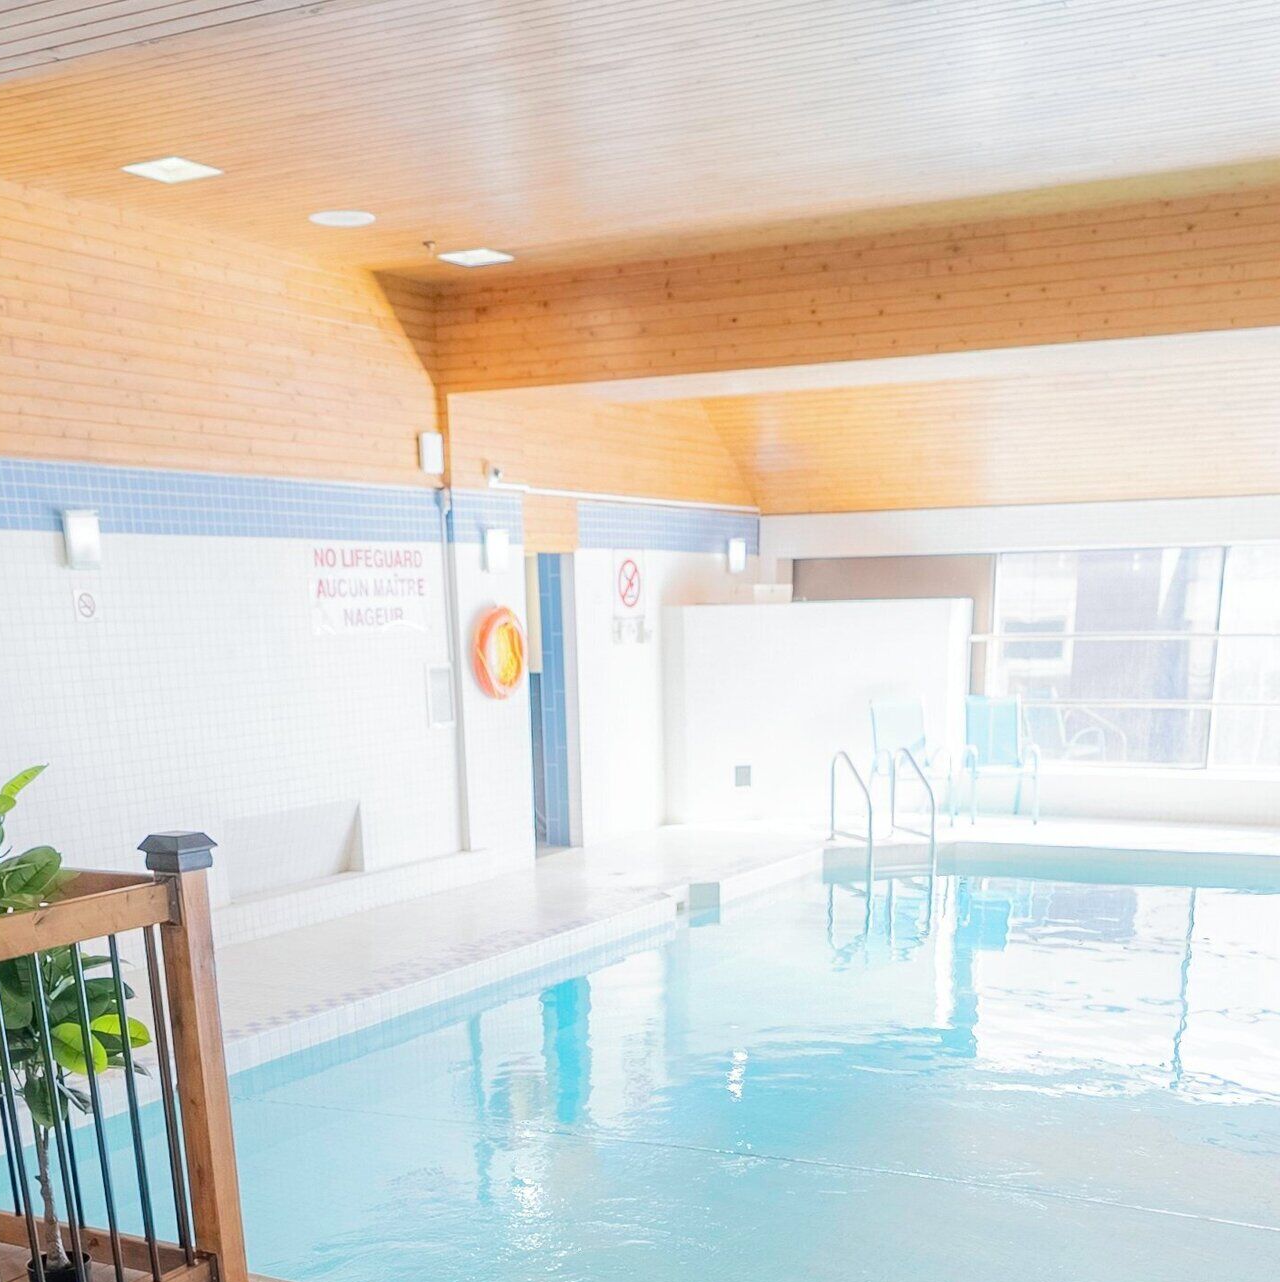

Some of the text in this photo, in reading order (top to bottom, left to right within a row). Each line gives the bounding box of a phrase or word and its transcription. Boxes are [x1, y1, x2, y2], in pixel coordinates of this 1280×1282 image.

[313, 548, 423, 569] NO LIFEGUARD
[317, 573, 425, 599] AUCUN MAÎTRE
[344, 607, 404, 627] NAGEUR
